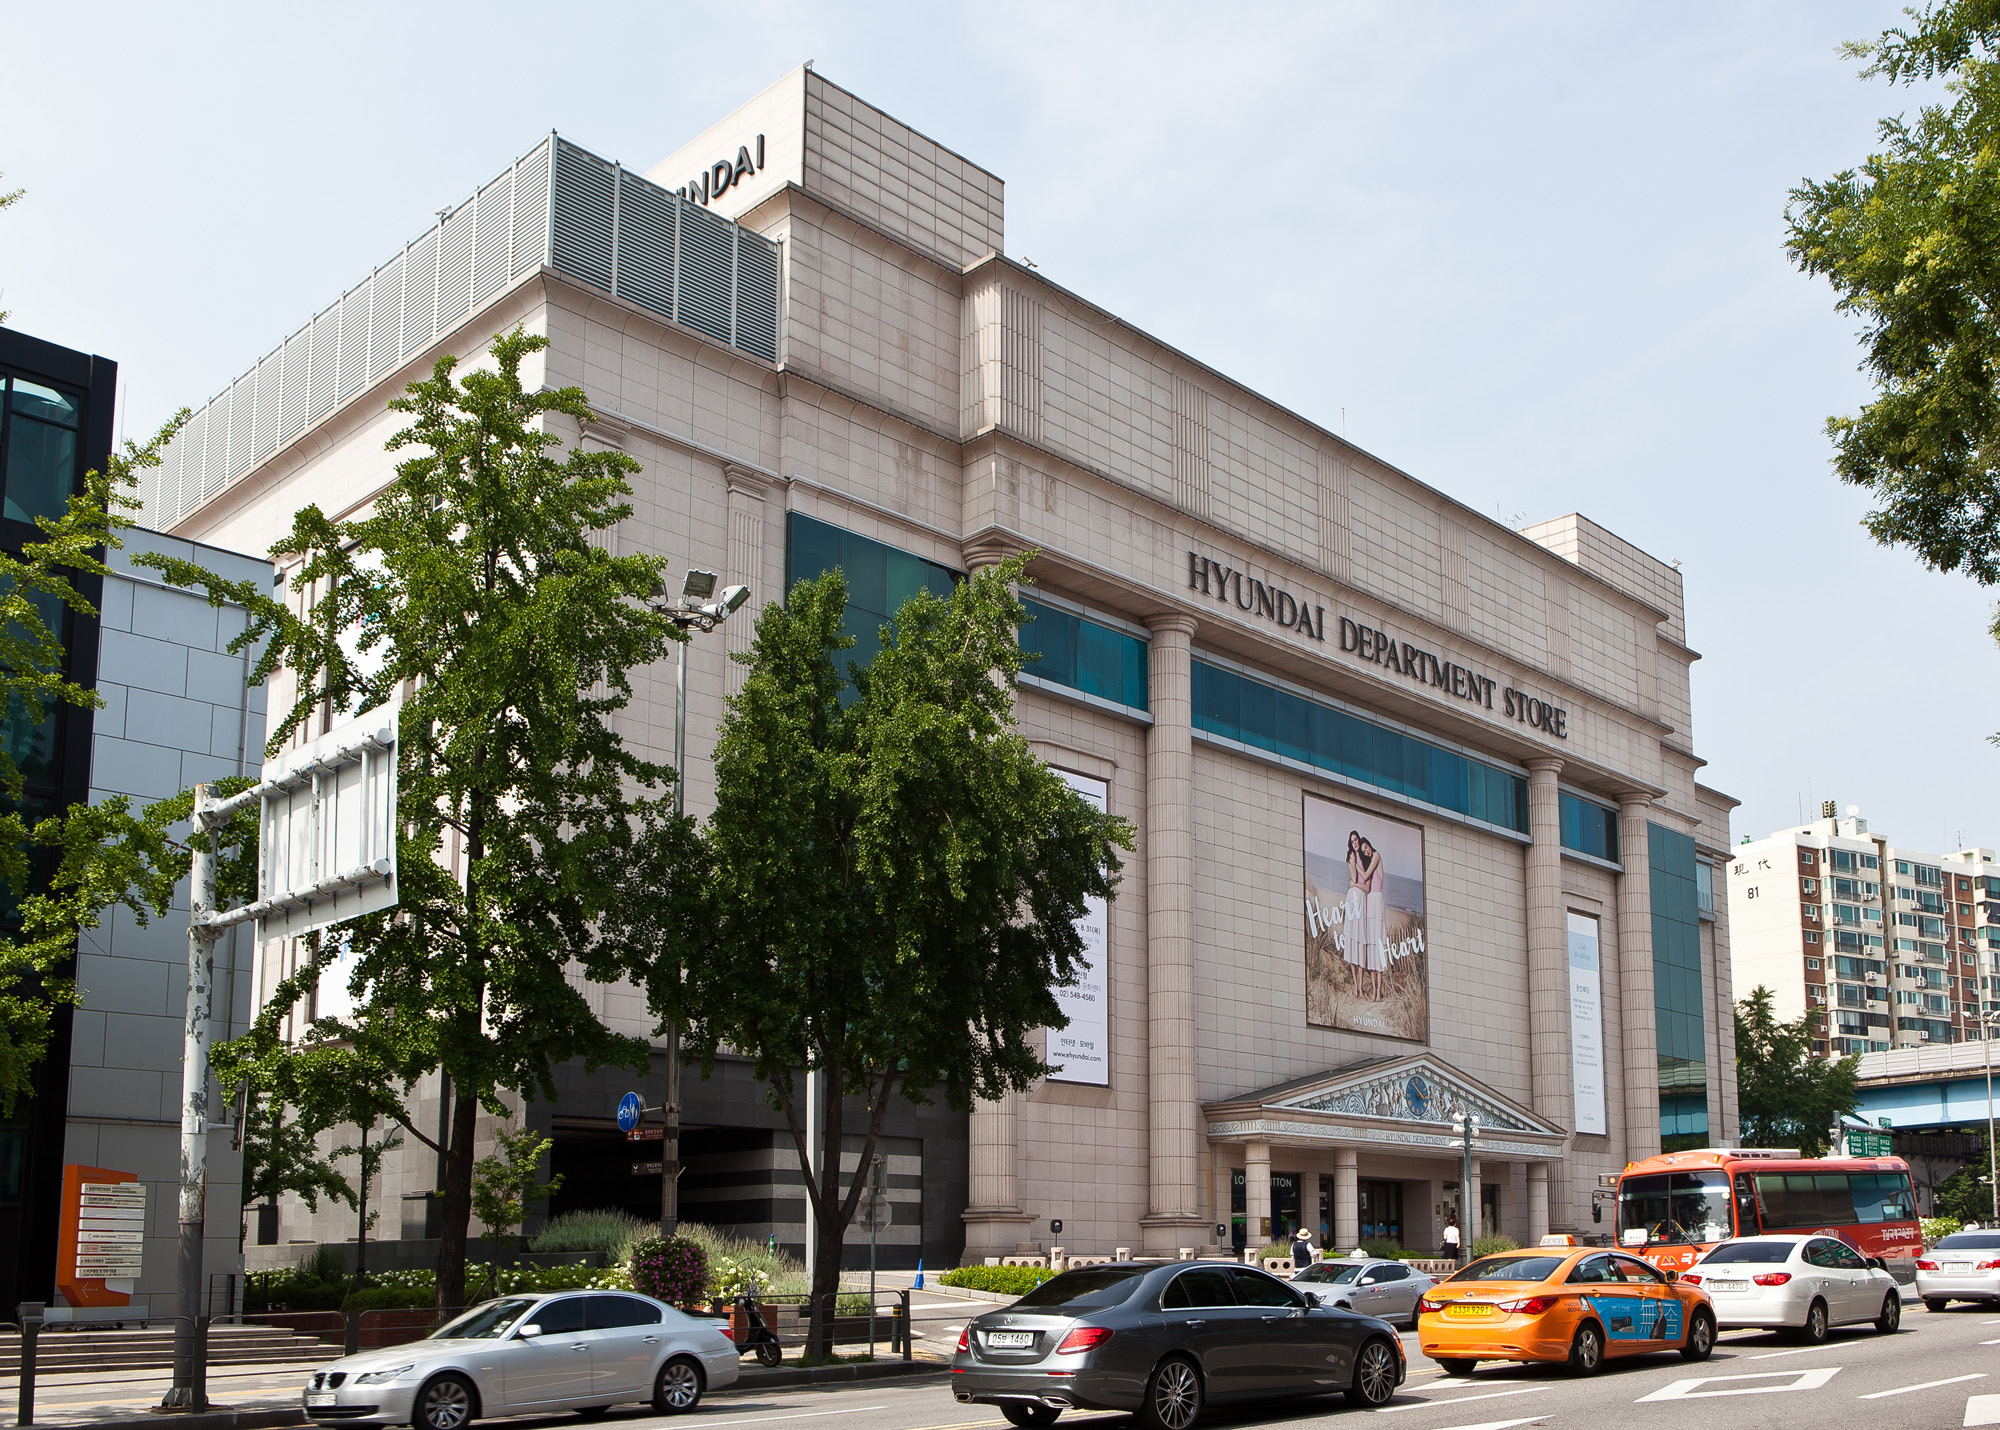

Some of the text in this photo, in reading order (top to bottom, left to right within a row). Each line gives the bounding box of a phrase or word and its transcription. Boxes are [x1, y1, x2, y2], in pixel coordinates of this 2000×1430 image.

[679, 134, 765, 205] NDAI
[1188, 550, 1568, 740] HYUNDAI DEPARTMENT STORE
[1747, 886, 1759, 900] 81
[1306, 891, 1362, 939] Heart
[1333, 928, 1425, 969] to Heart
[1070, 990, 1096, 1002] 549-4560
[1353, 1015, 1386, 1029] HYUNDAI
[1060, 1037, 1095, 1050] 인터넷 모바일
[1053, 1051, 1102, 1062] www.ehyundai.com
[1385, 1132, 1411, 1143] HYUNDAI
[1412, 1135, 1447, 1146] DEPARTMENT
[1270, 1177, 1292, 1188] ITTON
[1543, 1237, 1565, 1245] TAXI
[1471, 1306, 1488, 1314] 9291
[1010, 1333, 1030, 1344] 1460
